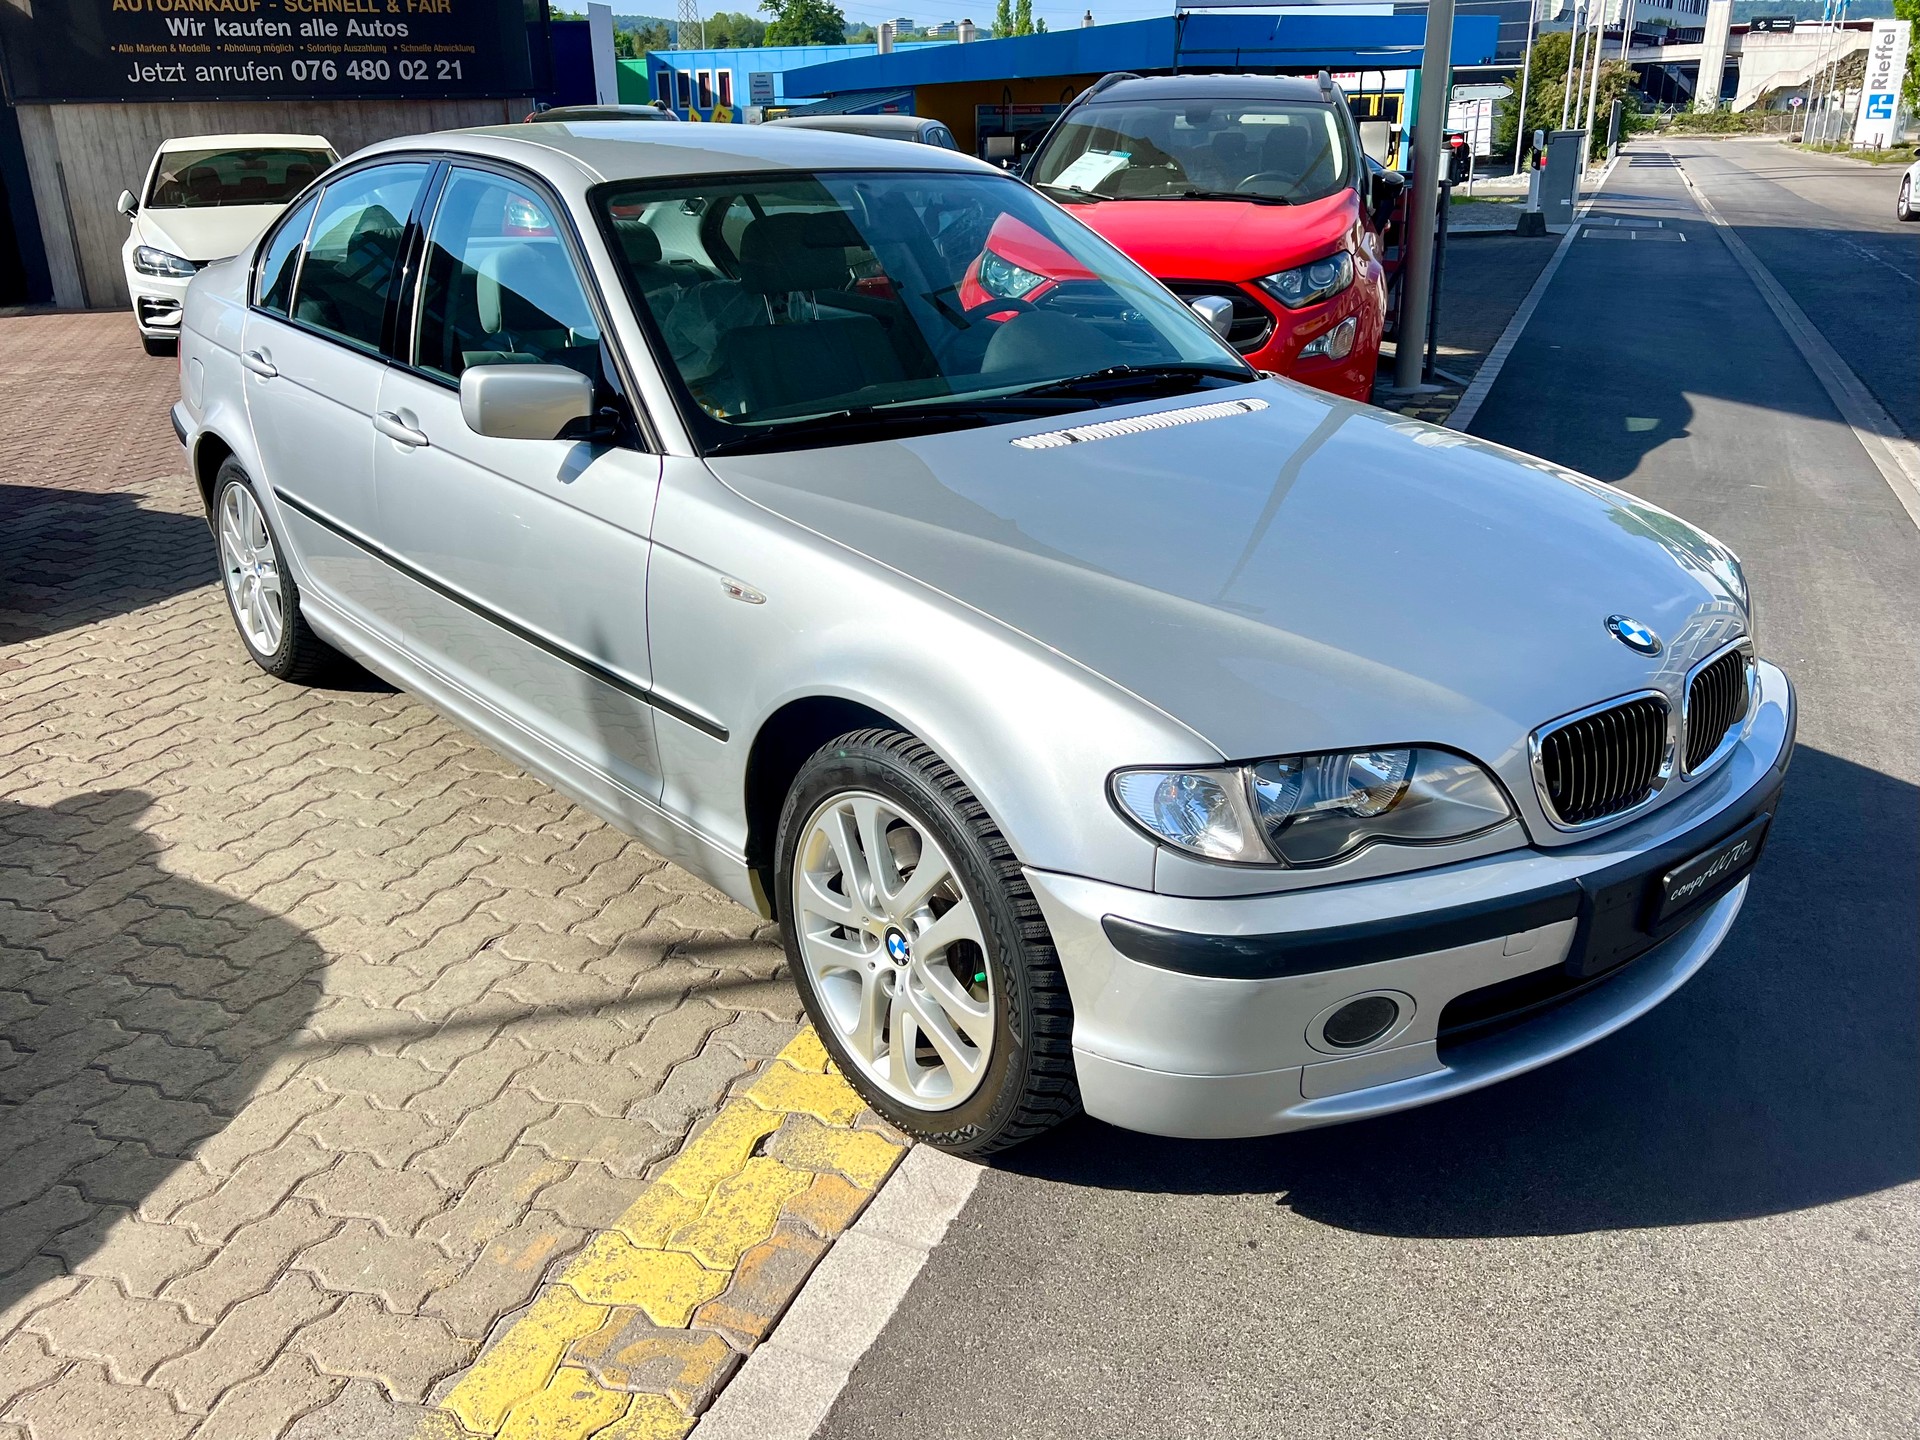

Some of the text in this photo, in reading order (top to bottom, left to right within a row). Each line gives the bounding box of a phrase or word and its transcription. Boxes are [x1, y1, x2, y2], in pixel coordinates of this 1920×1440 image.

[112, 0, 261, 12] AUTOANKAUF
[284, 0, 381, 13] SCHNELL
[386, 0, 400, 13] &
[406, 0, 452, 13] FAIR
[165, 18, 409, 37] Wir kaufen alle Autos
[118, 44, 211, 53] Alle Marken & Modelle
[224, 43, 294, 54] Abholung möglich
[306, 43, 387, 54] Sofortige Auszahlung
[400, 43, 476, 54] Schnelle Abwicklung
[1871, 28, 1897, 90] Rieffel
[127, 60, 462, 83] Jetzt anrufen 076 480 02 21
